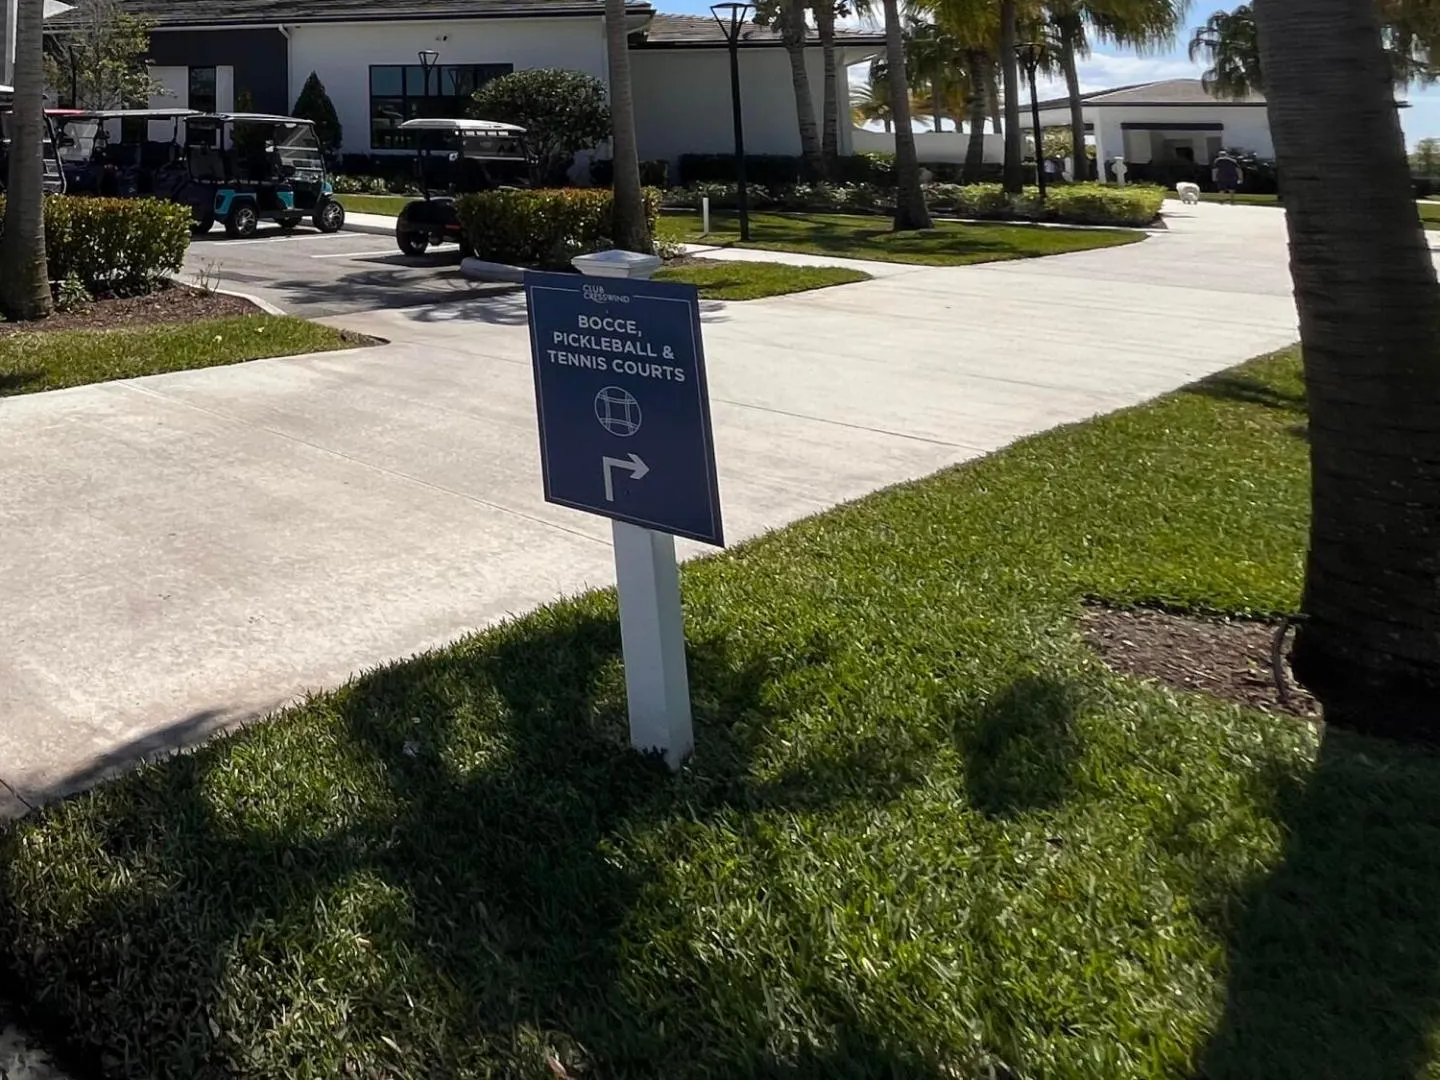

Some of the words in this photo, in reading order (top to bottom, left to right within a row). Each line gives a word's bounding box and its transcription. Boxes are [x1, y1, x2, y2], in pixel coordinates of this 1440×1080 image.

[583, 284, 605, 294] CLUB
[578, 315, 642, 337] BOCCE,
[553, 331, 658, 357] PICKLEBALL
[662, 345, 675, 359] &
[547, 350, 608, 370] TENNIS
[612, 359, 686, 382] COURTS
